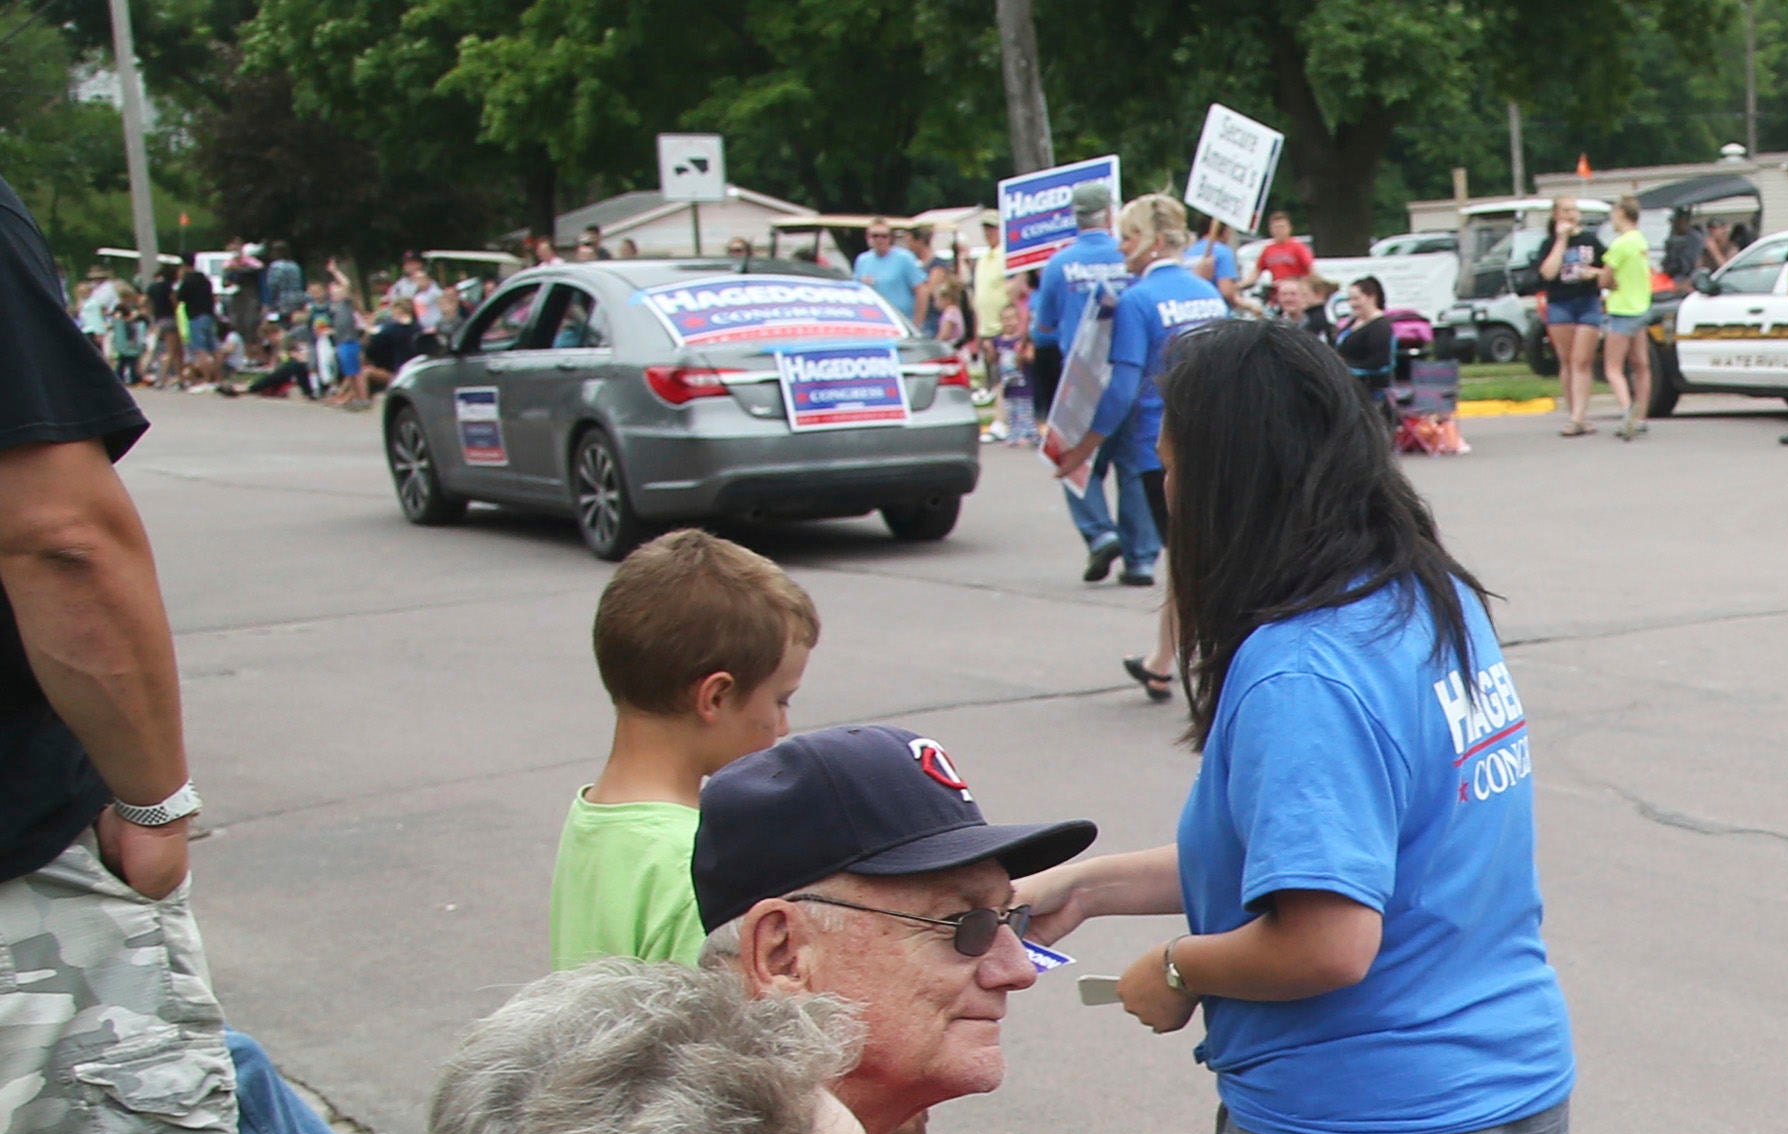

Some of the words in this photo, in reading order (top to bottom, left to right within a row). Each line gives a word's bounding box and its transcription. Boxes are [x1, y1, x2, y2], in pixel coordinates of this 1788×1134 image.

[1005, 178, 1095, 220] HAGED
[653, 284, 877, 313] HAGEDORN
[710, 307, 855, 324] CONGRESS
[785, 356, 898, 383] HAGEDORN
[810, 386, 885, 403] CONGRESS
[1434, 662, 1524, 754] HAGE
